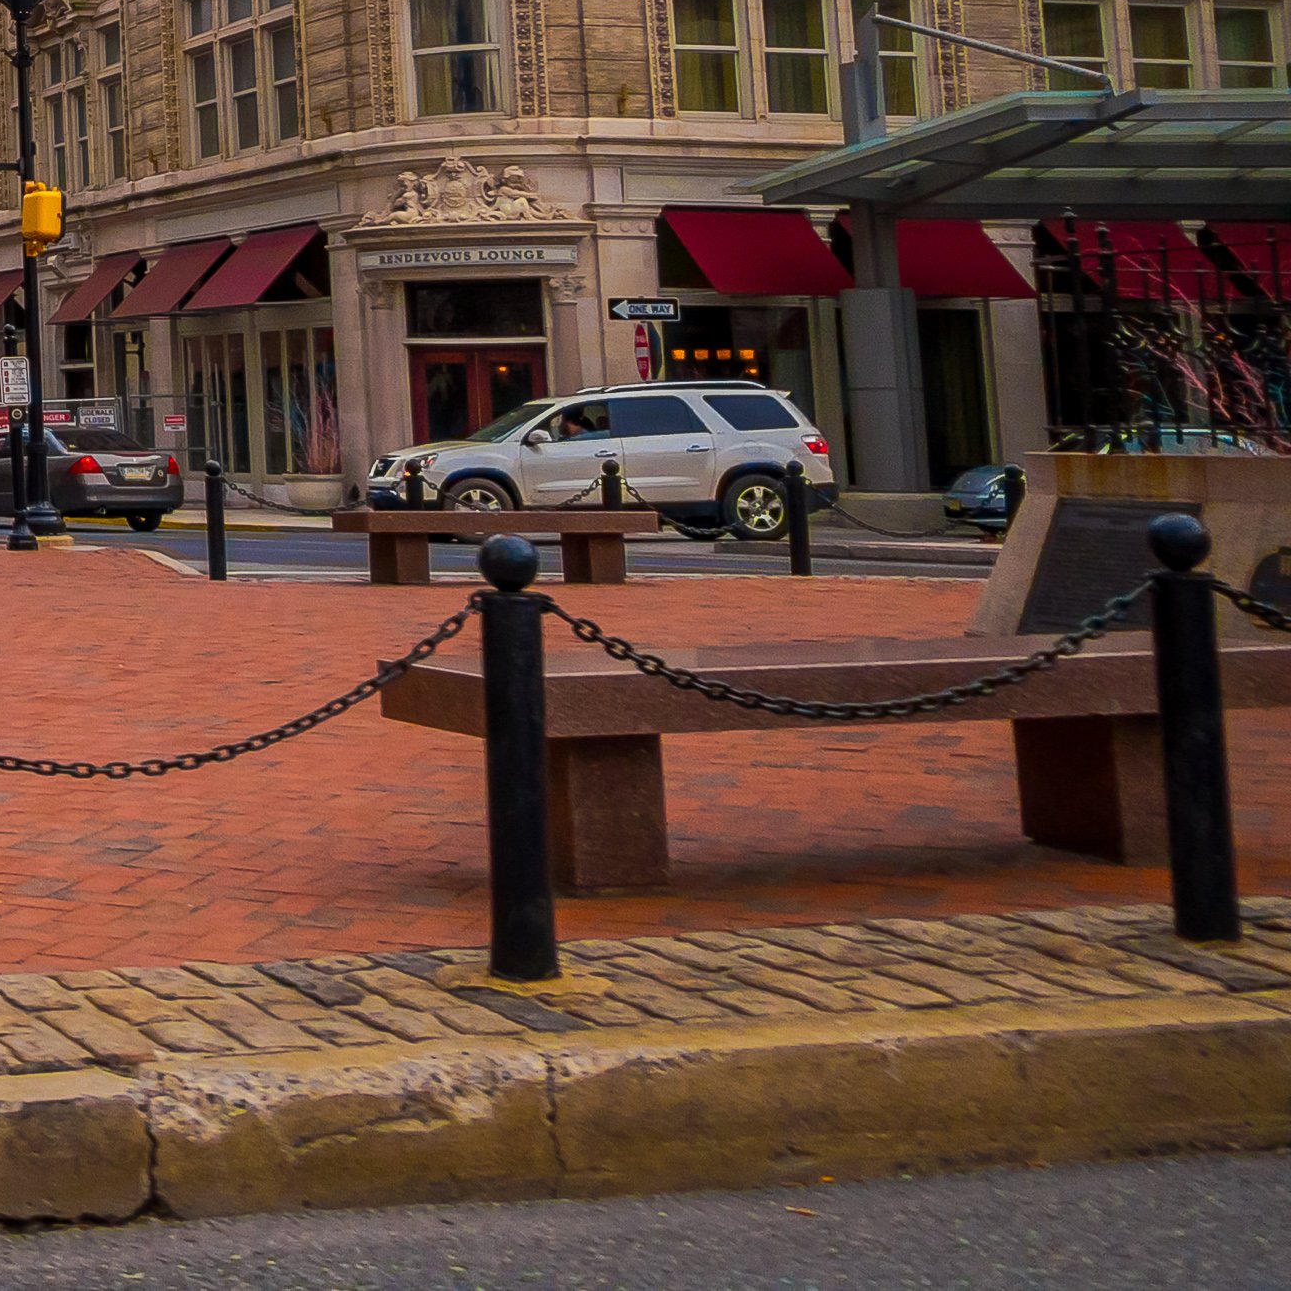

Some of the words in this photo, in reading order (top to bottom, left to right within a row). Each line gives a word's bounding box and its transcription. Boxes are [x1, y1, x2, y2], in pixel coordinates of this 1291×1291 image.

[379, 251, 472, 264] RENDEZVOUS
[478, 249, 545, 260] LOUNGE
[628, 304, 648, 314] ONE
[651, 304, 672, 314] WAY
[43, 414, 66, 422] NGER
[84, 416, 111, 424] CLOSED
